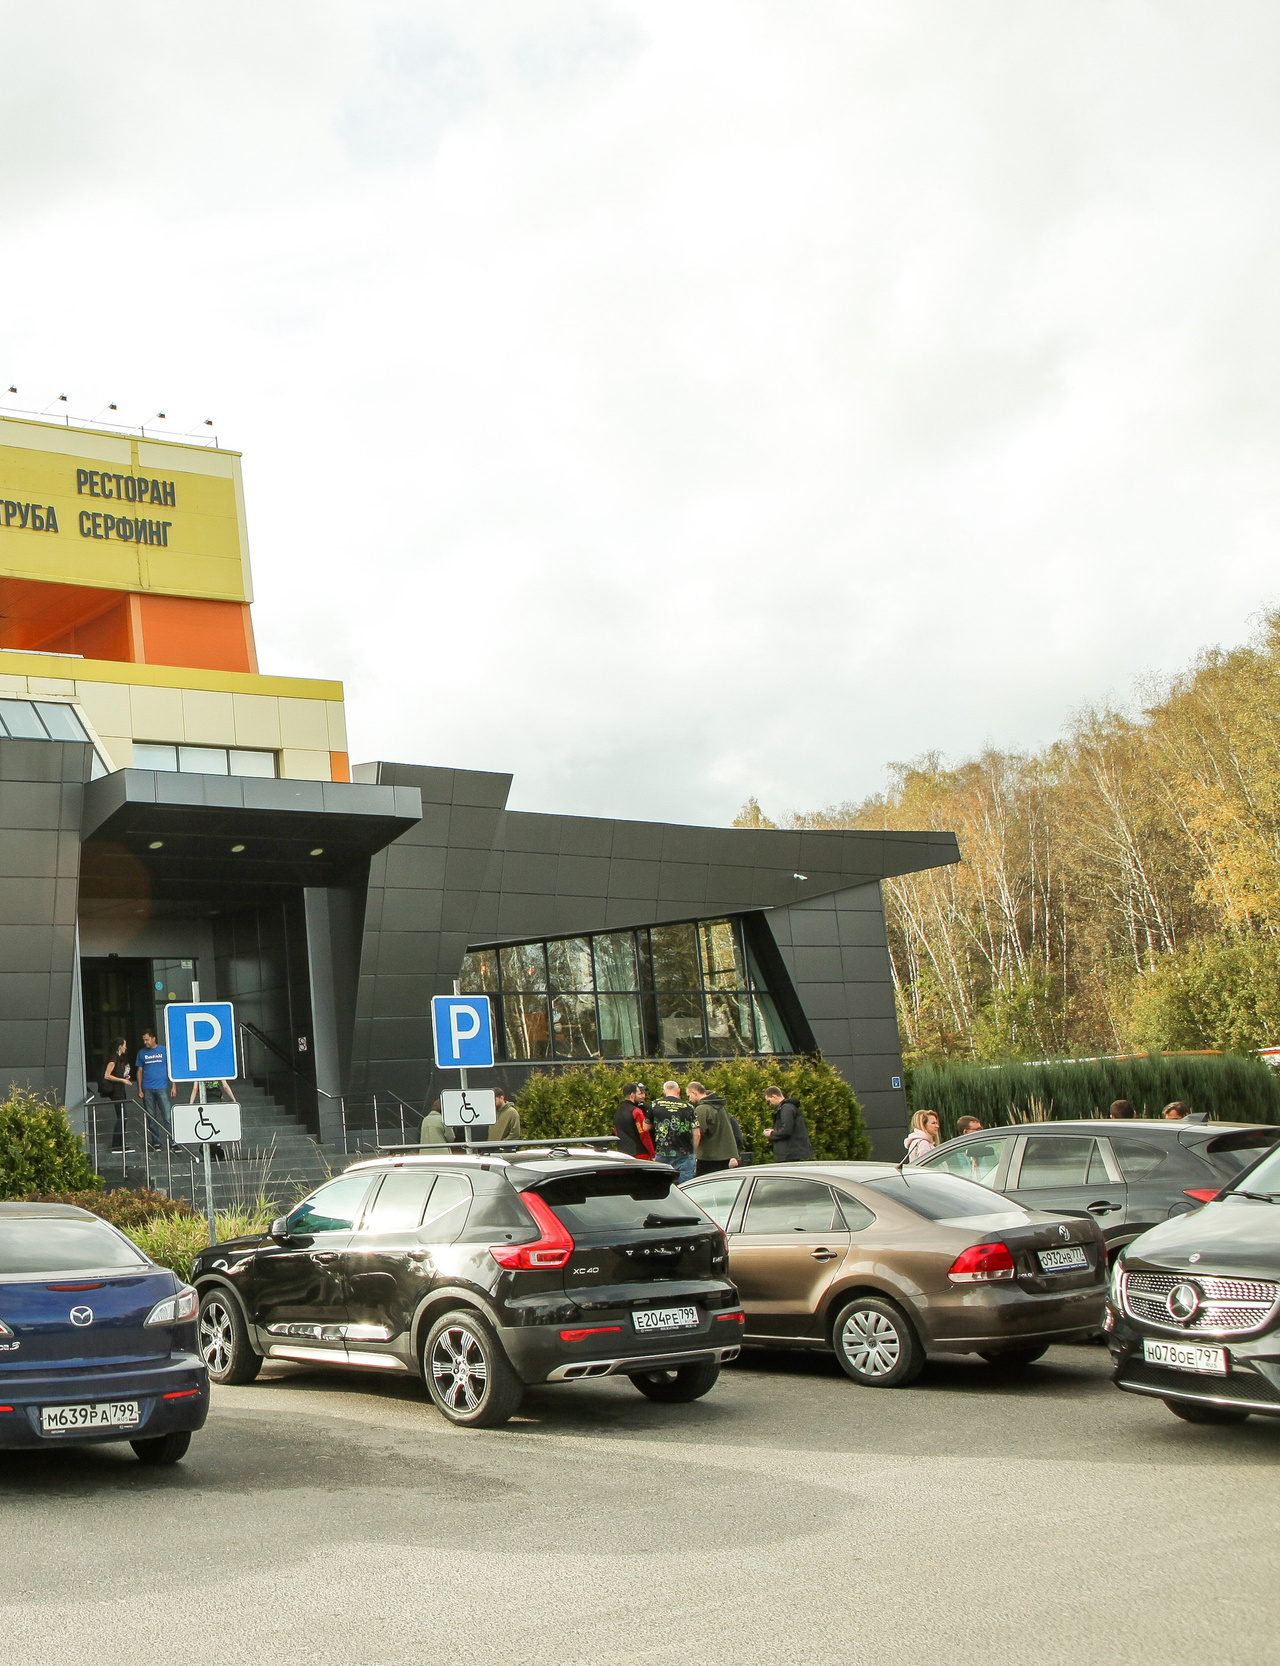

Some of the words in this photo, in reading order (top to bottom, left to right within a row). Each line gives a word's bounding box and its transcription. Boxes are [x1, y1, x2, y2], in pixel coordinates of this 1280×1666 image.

[76, 468, 177, 507] РЕСТОРАН
[78, 510, 173, 547] СЕРФИНГ
[185, 1012, 222, 1072] P
[448, 1004, 481, 1059] P
[1070, 1248, 1081, 1259] 777
[636, 1311, 680, 1328] Е204РЕ
[678, 1308, 695, 1319] 799
[1147, 1344, 1195, 1365] Н078ОЕ
[1196, 1348, 1219, 1363] 797
[47, 1407, 110, 1427] М639РА
[111, 1403, 135, 1418] 799
